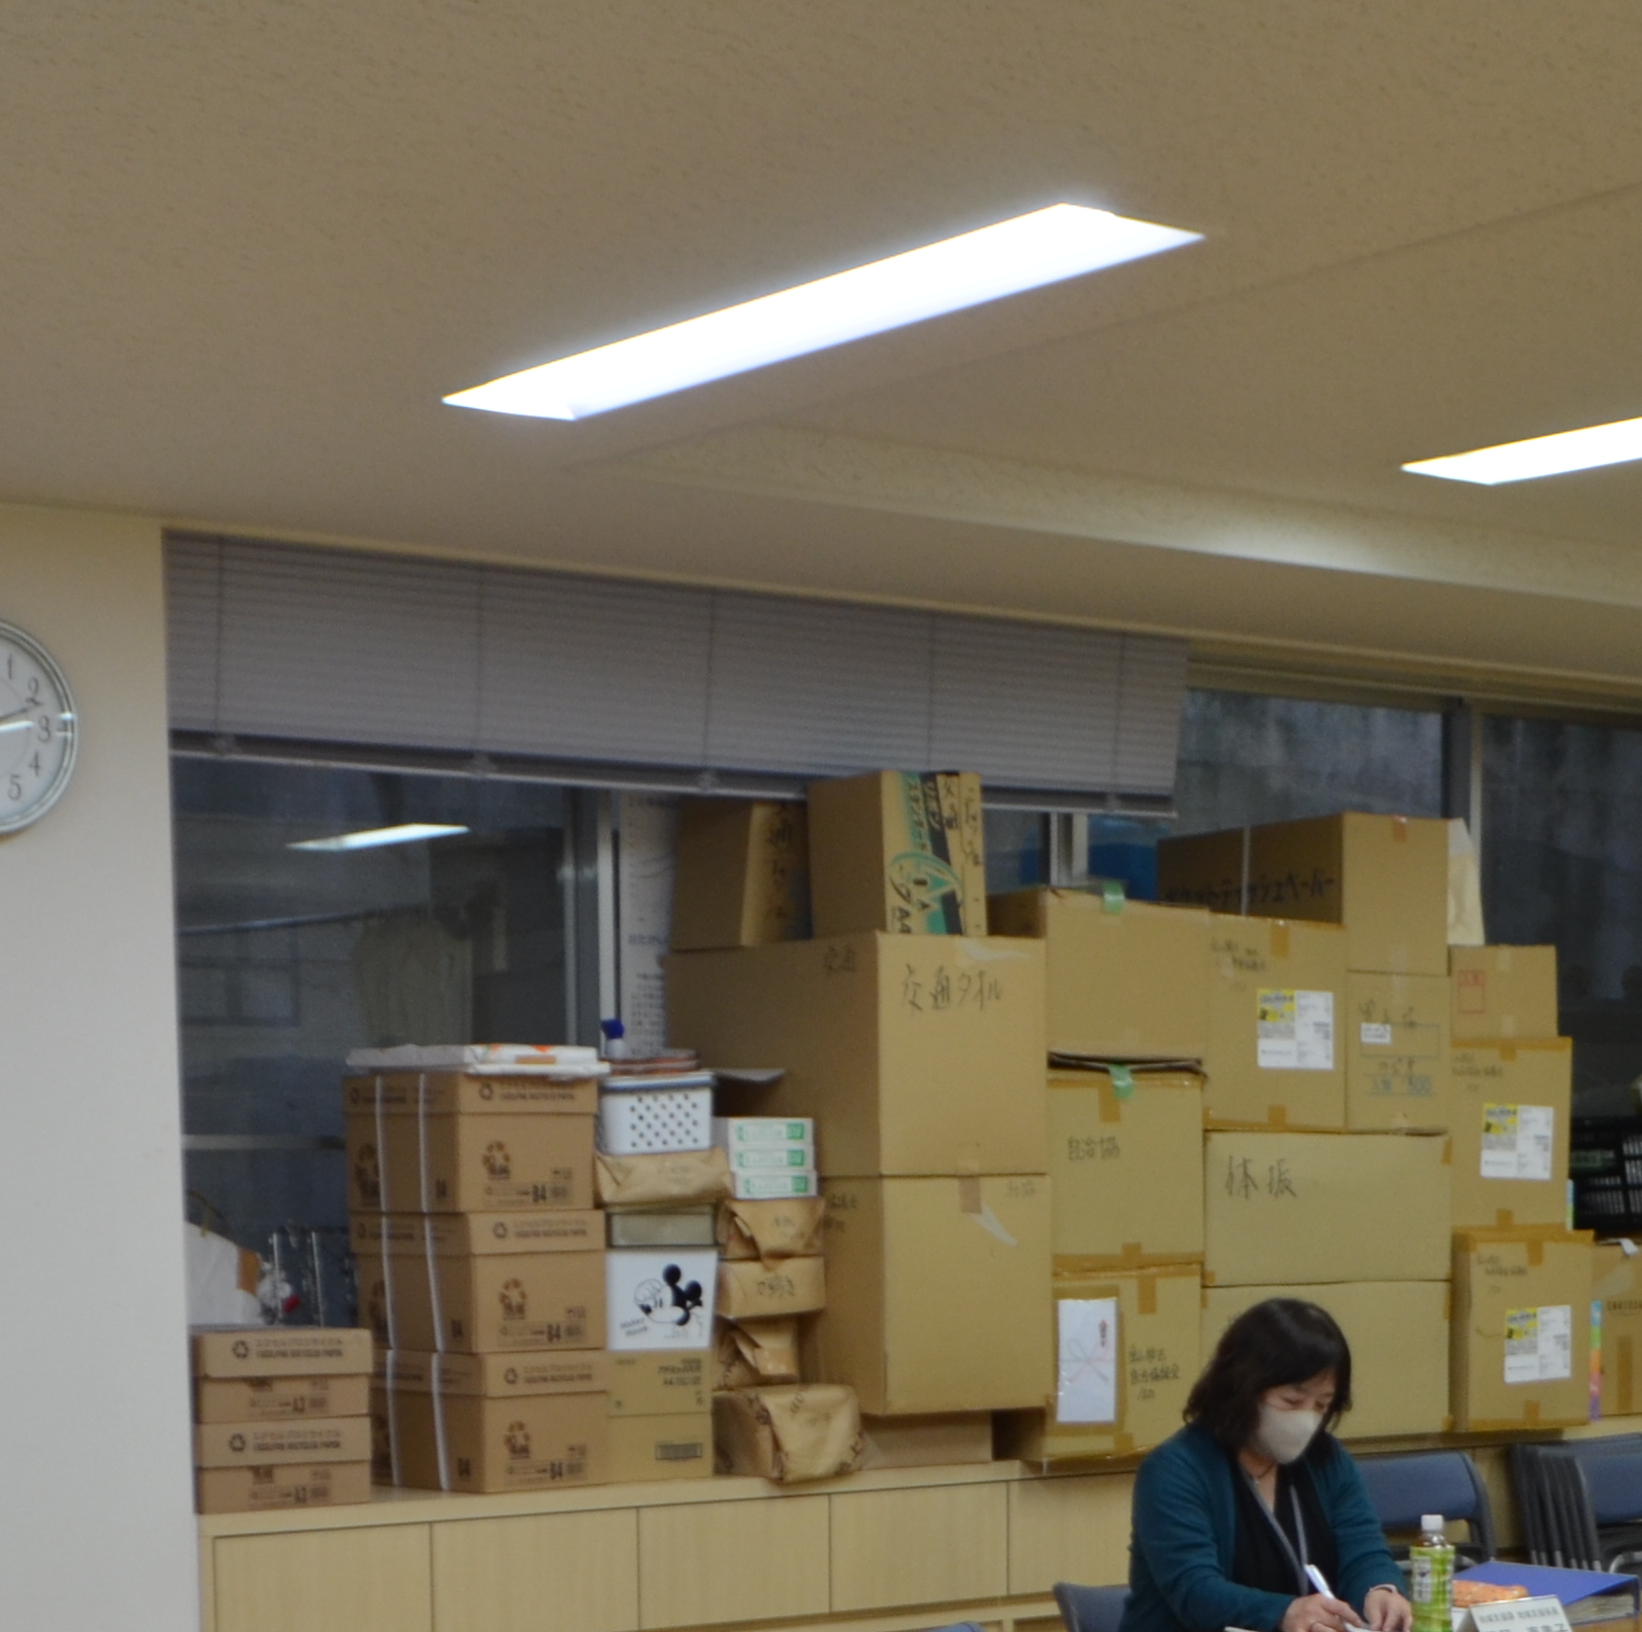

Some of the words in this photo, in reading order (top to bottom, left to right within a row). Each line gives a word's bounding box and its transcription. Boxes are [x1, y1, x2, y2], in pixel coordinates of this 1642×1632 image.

[25, 677, 43, 707] 2
[37, 714, 51, 743] 3
[29, 749, 43, 778] 4
[7, 774, 23, 801] 5
[1068, 1134, 1120, 1161] 自治協
